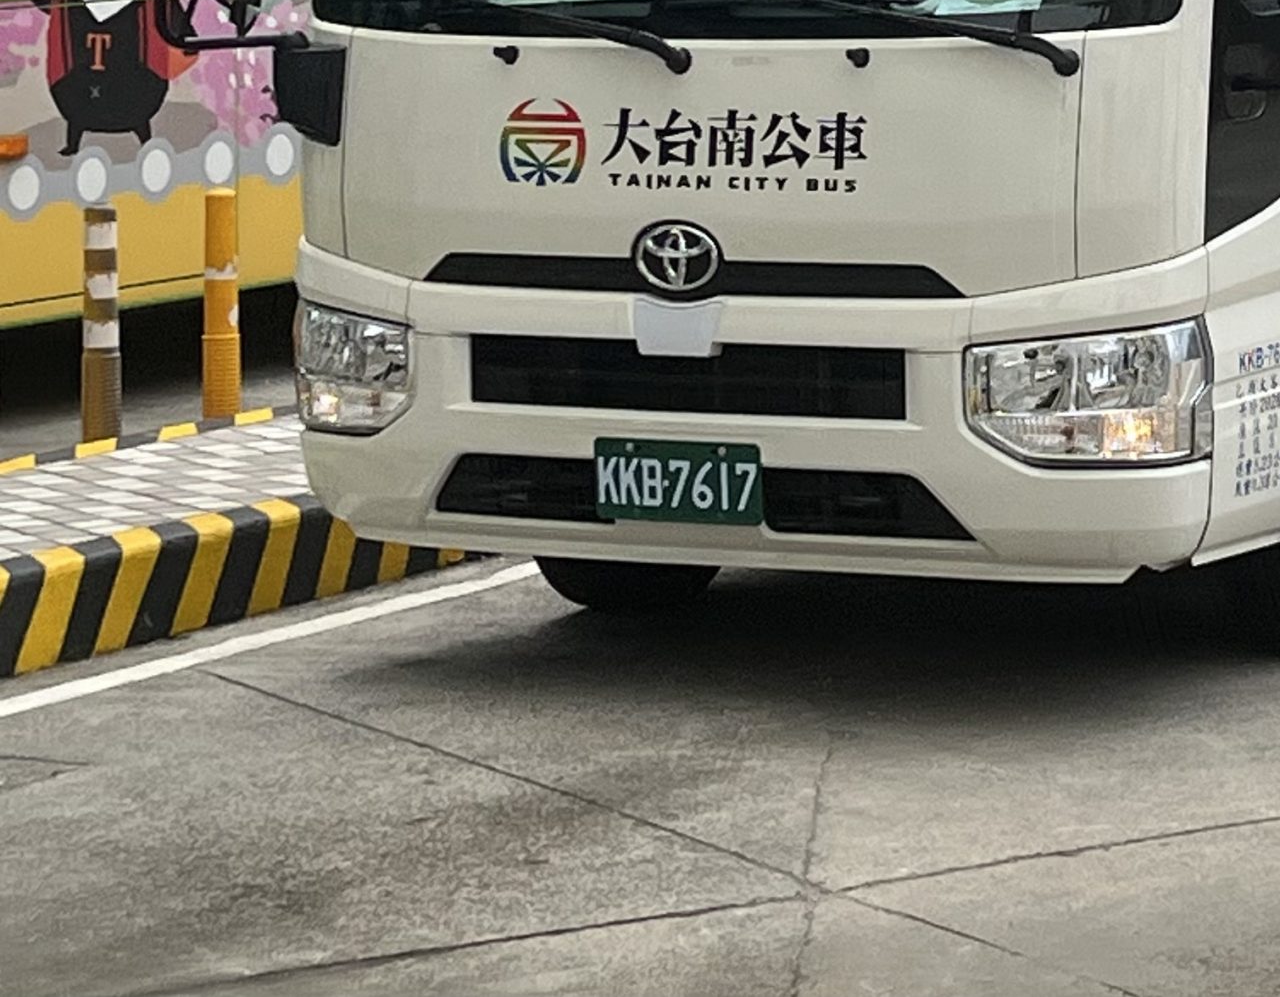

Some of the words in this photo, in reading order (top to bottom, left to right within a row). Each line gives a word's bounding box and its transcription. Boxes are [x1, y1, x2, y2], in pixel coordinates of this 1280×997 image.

[85, 33, 112, 71] T
[600, 107, 868, 170] 大台南公車
[608, 173, 712, 190] TAINAN
[728, 175, 789, 191] CITY
[806, 177, 858, 193] BUS
